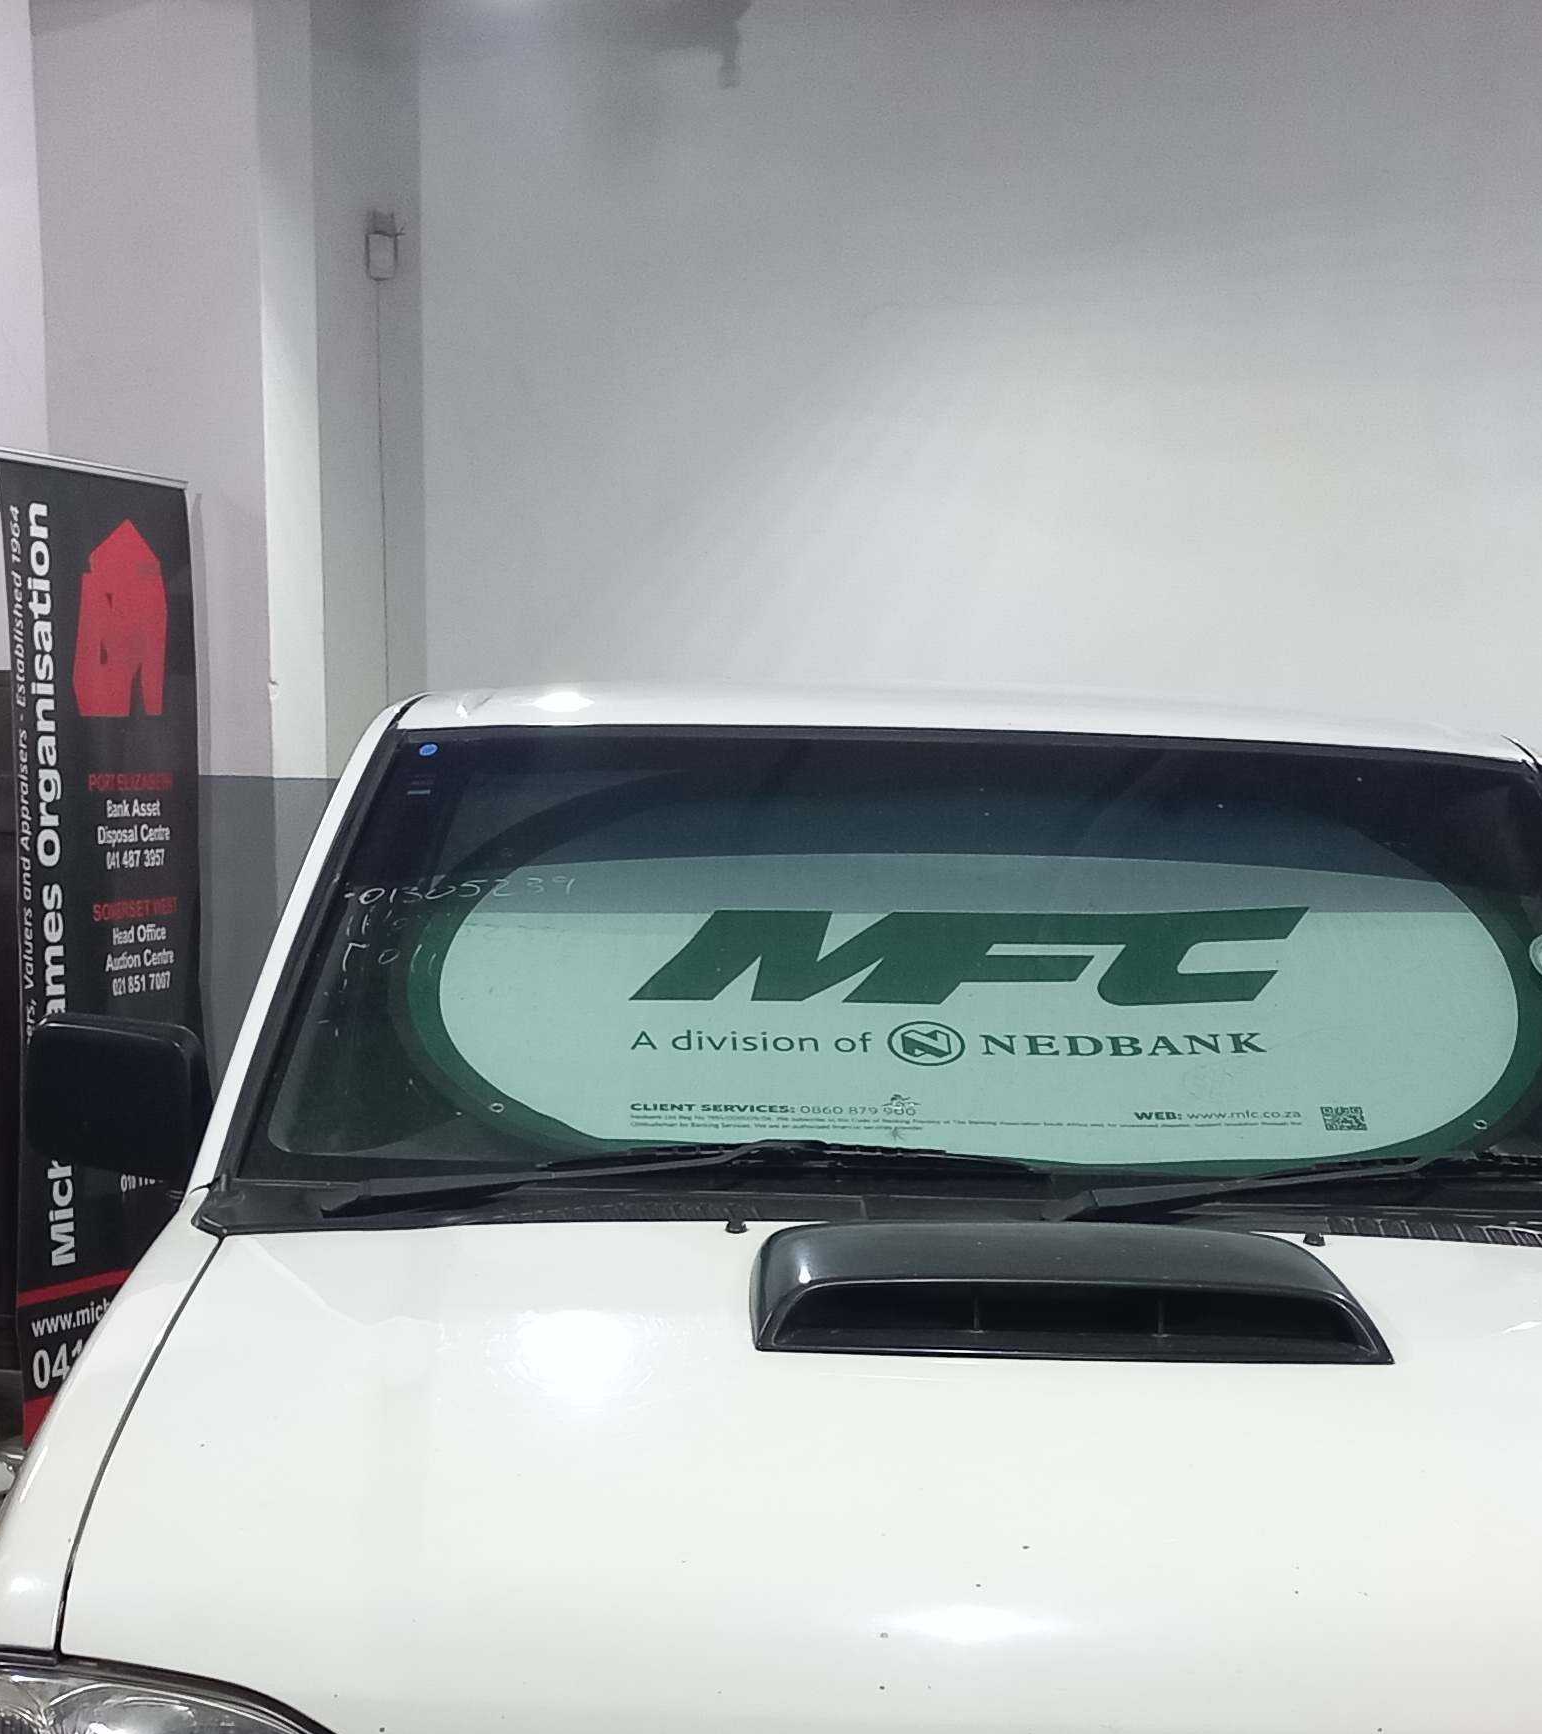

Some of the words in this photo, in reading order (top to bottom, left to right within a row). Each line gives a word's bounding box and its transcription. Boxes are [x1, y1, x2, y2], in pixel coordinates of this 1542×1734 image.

[9, 505, 21, 563] 1964
[10, 570, 26, 708] Established
[26, 502, 62, 867] Organisation
[17, 728, 32, 851] Appraisers
[20, 856, 32, 901] and
[22, 907, 35, 990] Valuers
[128, 974, 146, 993] 851
[629, 907, 1310, 1006] MFC
[630, 1030, 658, 1051] A
[671, 1029, 820, 1052] division
[834, 1031, 872, 1053] of
[978, 1032, 1268, 1057] NEDBANK
[630, 1102, 696, 1112] CLIENT
[701, 1104, 796, 1114] SERVICES:
[848, 1106, 879, 1115] 879
[1134, 1111, 1182, 1121] WEB:
